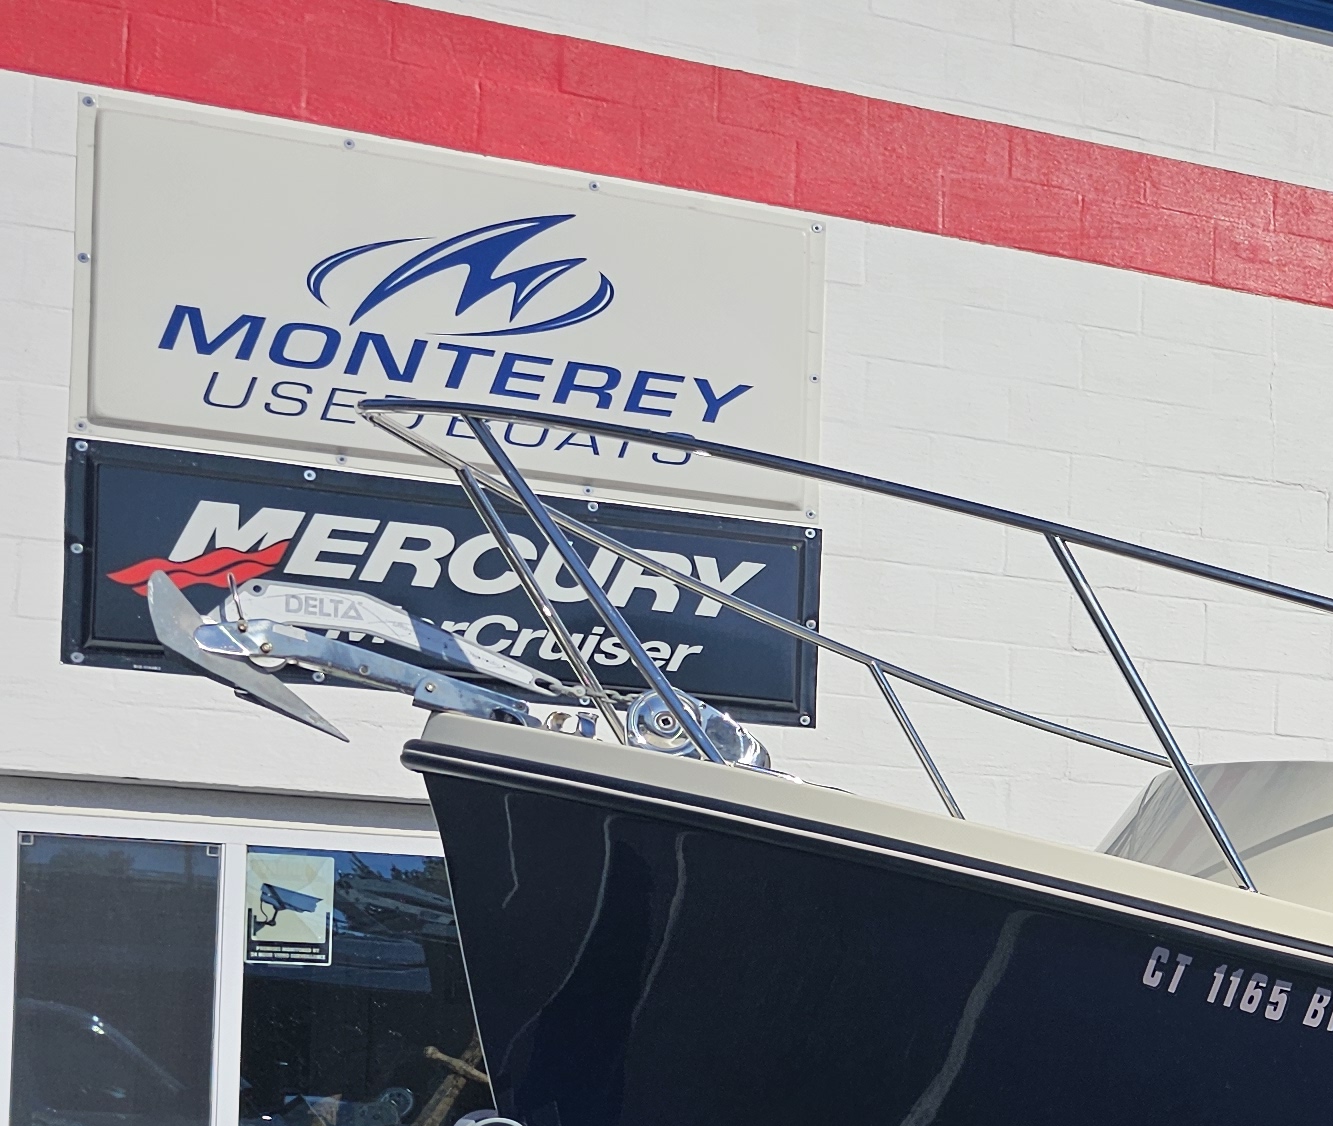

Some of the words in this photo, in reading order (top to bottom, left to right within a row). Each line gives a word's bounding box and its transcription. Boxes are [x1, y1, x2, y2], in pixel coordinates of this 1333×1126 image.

[157, 304, 754, 424] MONTEREY
[167, 500, 767, 618] MERCURY
[284, 593, 364, 621] DELTA
[1142, 946, 1193, 995] CT
[1207, 963, 1292, 1022] 1165
